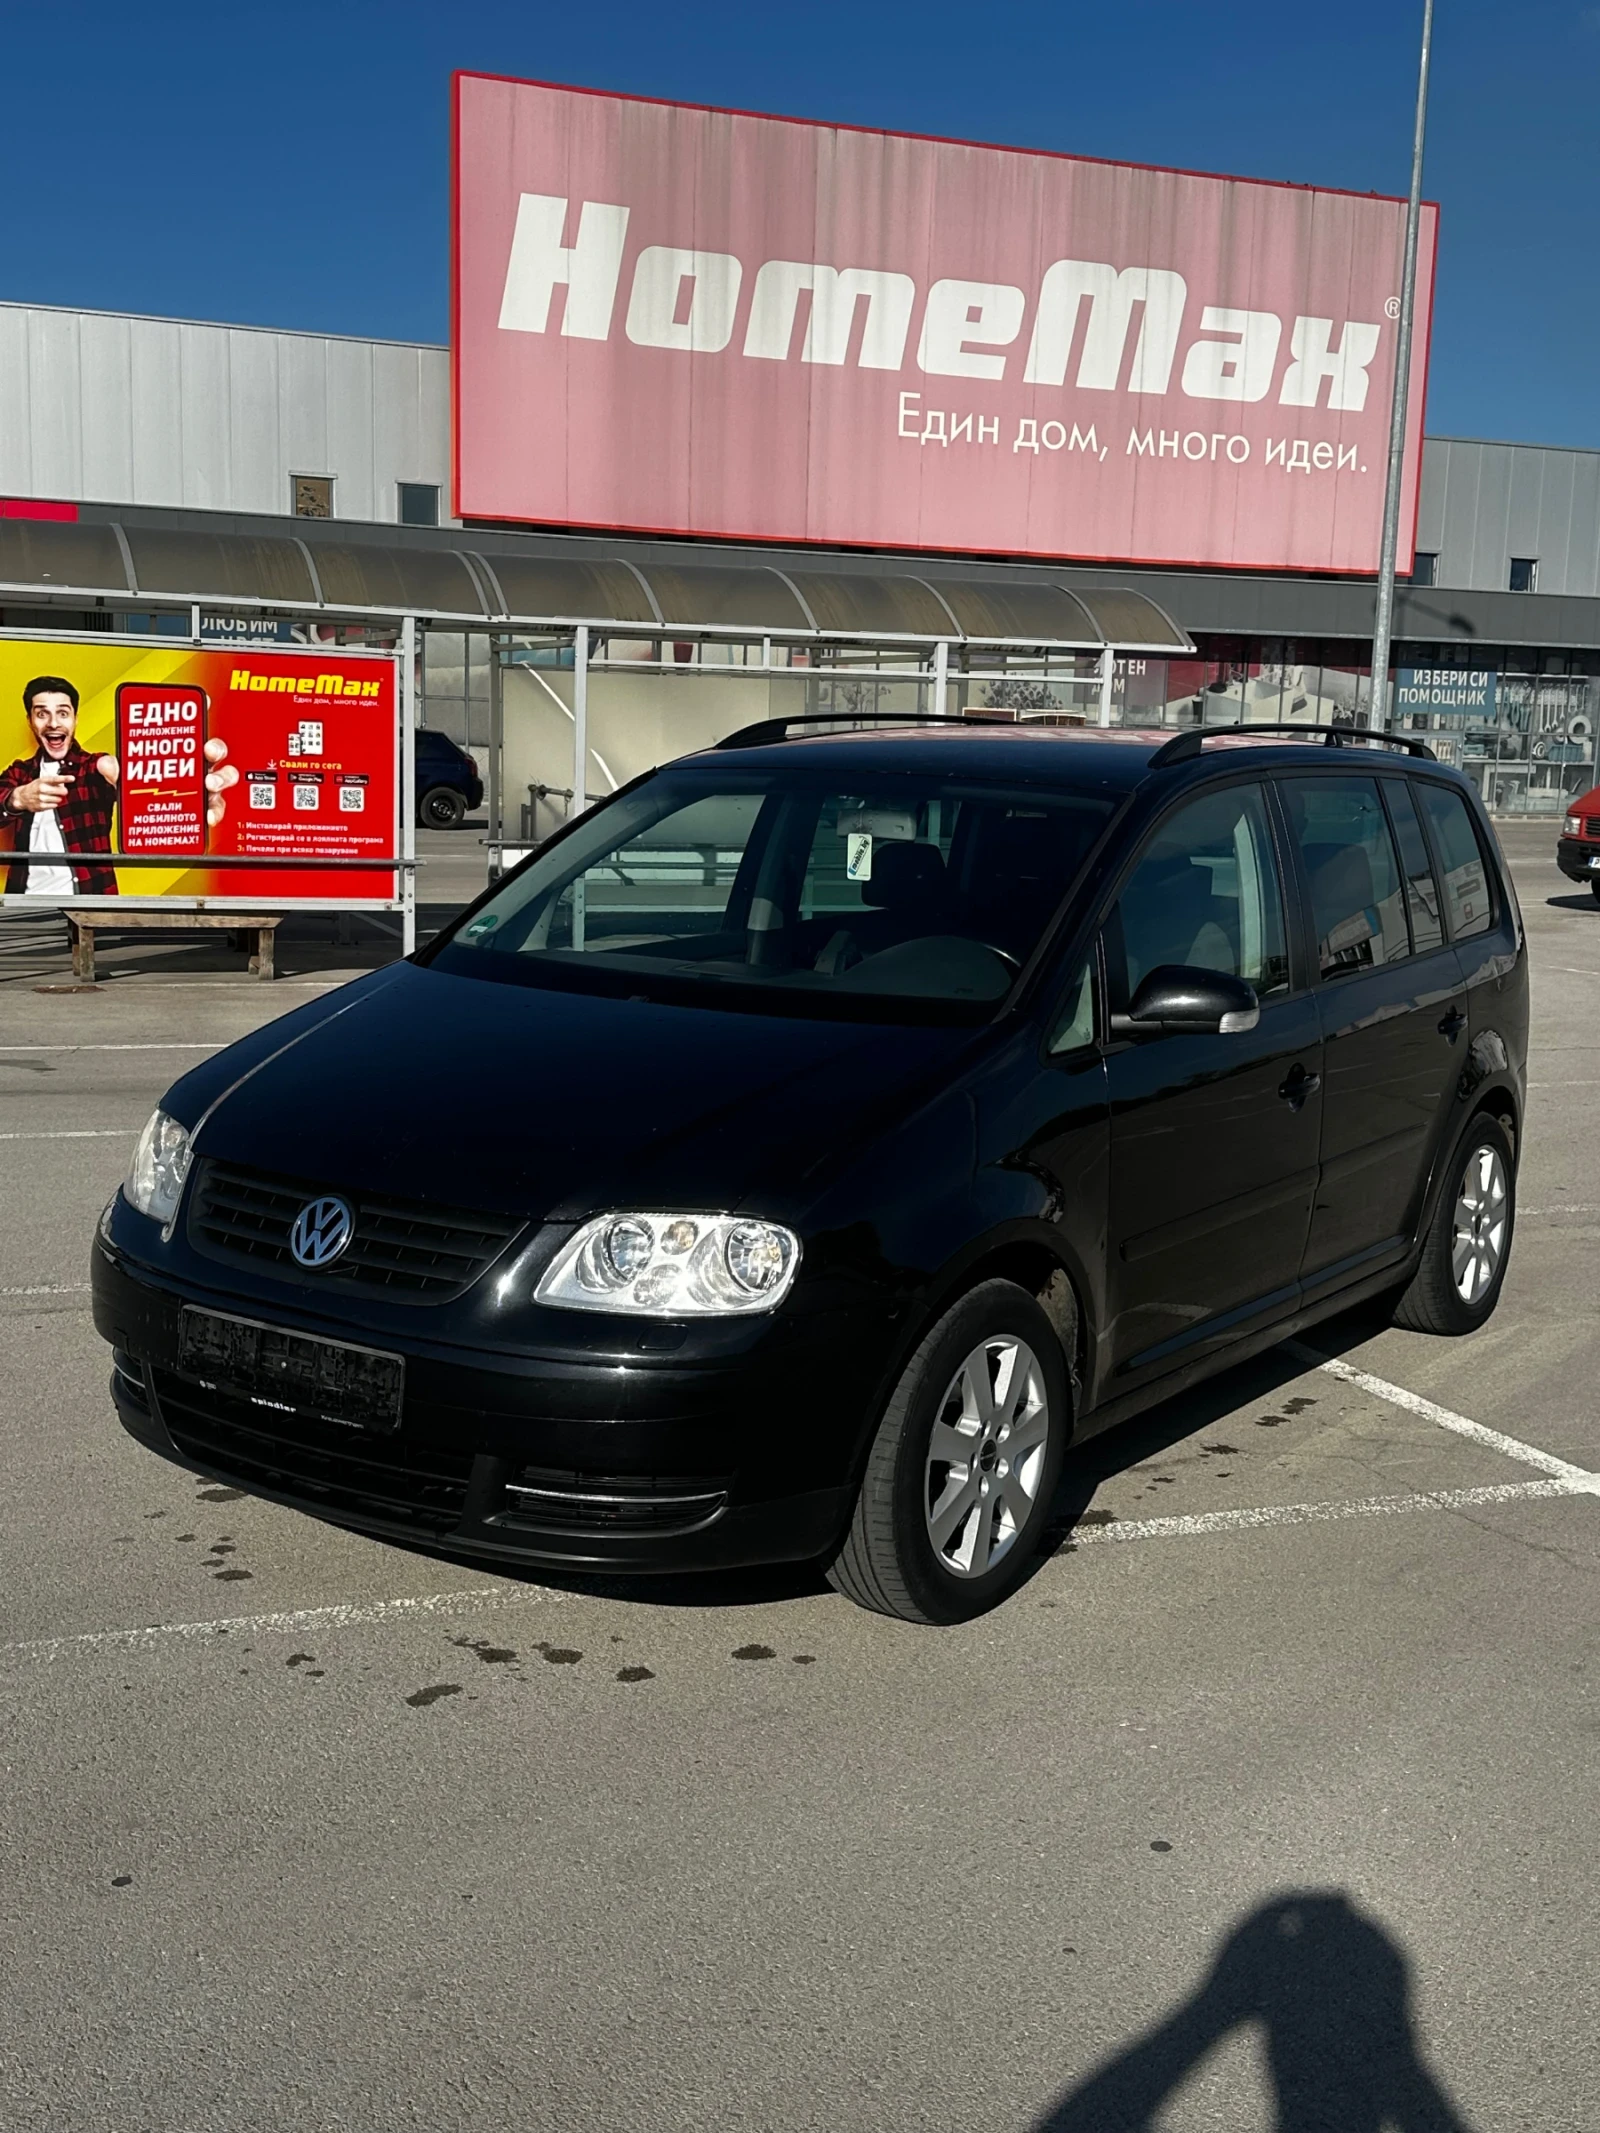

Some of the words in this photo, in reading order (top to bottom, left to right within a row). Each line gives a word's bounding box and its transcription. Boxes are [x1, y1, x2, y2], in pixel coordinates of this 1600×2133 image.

[498, 192, 1381, 412] HomeMax
[897, 391, 1000, 447] Един
[1013, 418, 1110, 462] дом,
[1125, 426, 1251, 464] много
[1263, 437, 1368, 475] идеи.
[229, 669, 381, 697] HomeMax
[1413, 669, 1467, 687] ИЗБЕРИ
[1470, 671, 1489, 687] СИ
[293, 695, 313, 704] Един
[1398, 688, 1487, 707] ПОМОЩНИК
[128, 701, 198, 727] ЕДНО
[129, 726, 196, 737] ПРИЛОЖЕНИЕ
[127, 738, 196, 757] МНОГО
[279, 760, 308, 768] Свали
[126, 758, 196, 783] ИДЕИ
[147, 803, 183, 812] СВАЛИ
[133, 813, 197, 824] МОБИЛНОТО
[128, 824, 201, 836] ПРИЛОЖЕНИЕ
[246, 822, 292, 831] Инсталирай
[128, 838, 143, 847] НА
[246, 833, 295, 843] Регистрирай
[348, 837, 384, 845] програма
[246, 845, 275, 853] Печели
